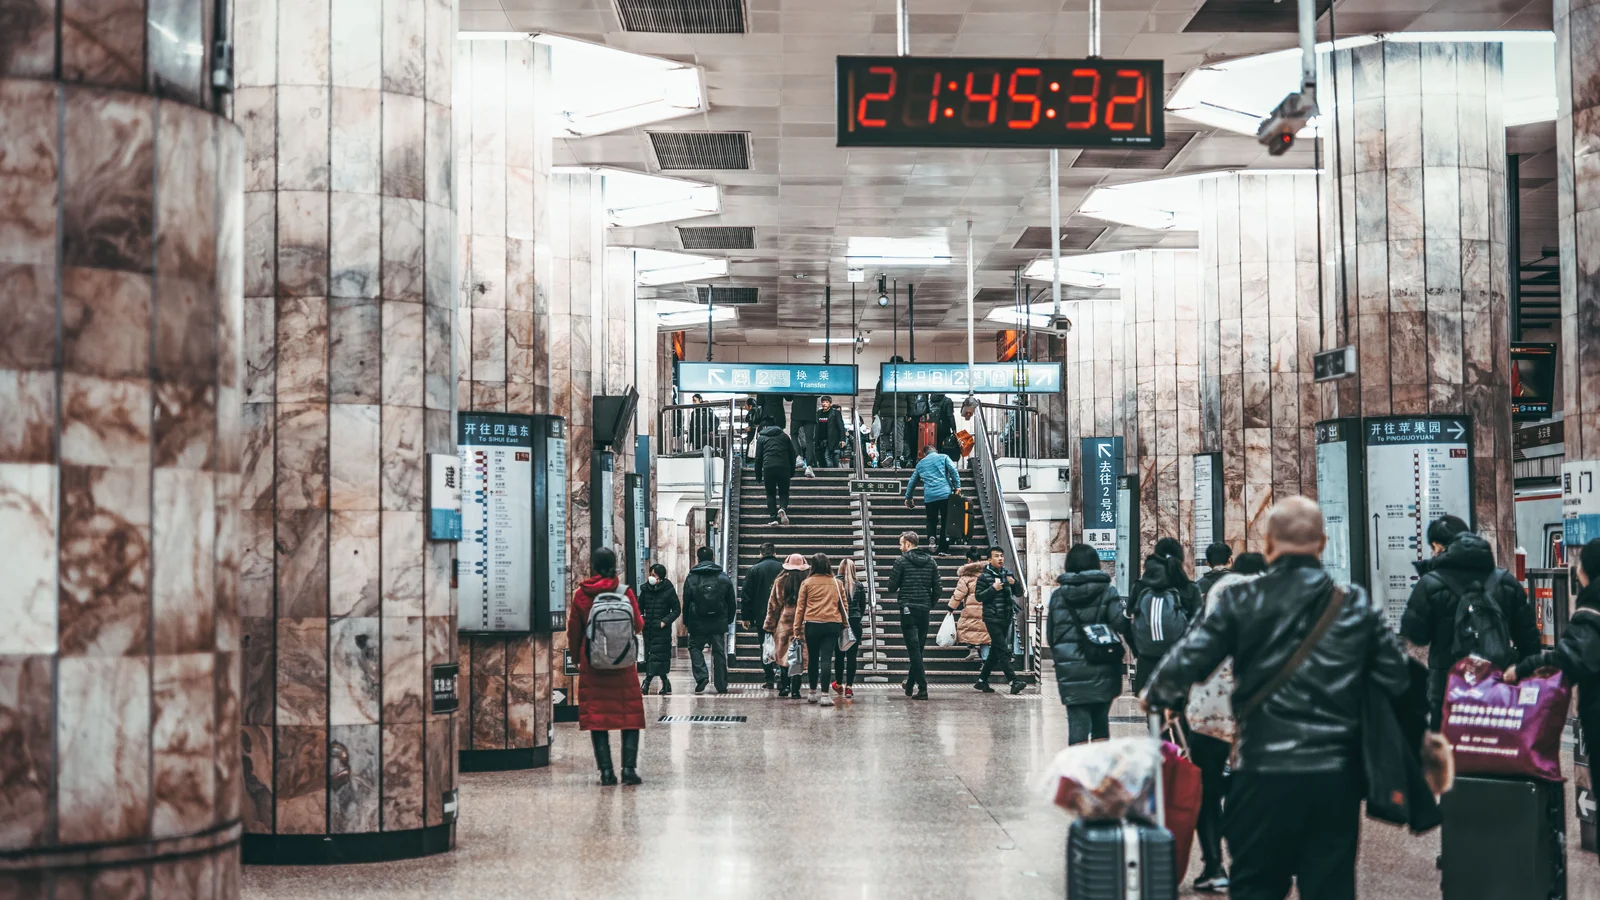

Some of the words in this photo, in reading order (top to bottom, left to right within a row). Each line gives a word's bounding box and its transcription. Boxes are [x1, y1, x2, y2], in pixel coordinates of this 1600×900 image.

[857, 66, 1144, 131] 21:45:32
[796, 370, 829, 381] 换乘
[932, 371, 943, 385] B
[799, 381, 827, 389] Transfer
[464, 423, 529, 437] 开往四惠东
[1328, 424, 1337, 437] 出
[1371, 421, 1441, 436] 开往苹果园
[1099, 461, 1113, 523] 去往2号线
[1088, 532, 1110, 542] 建国
